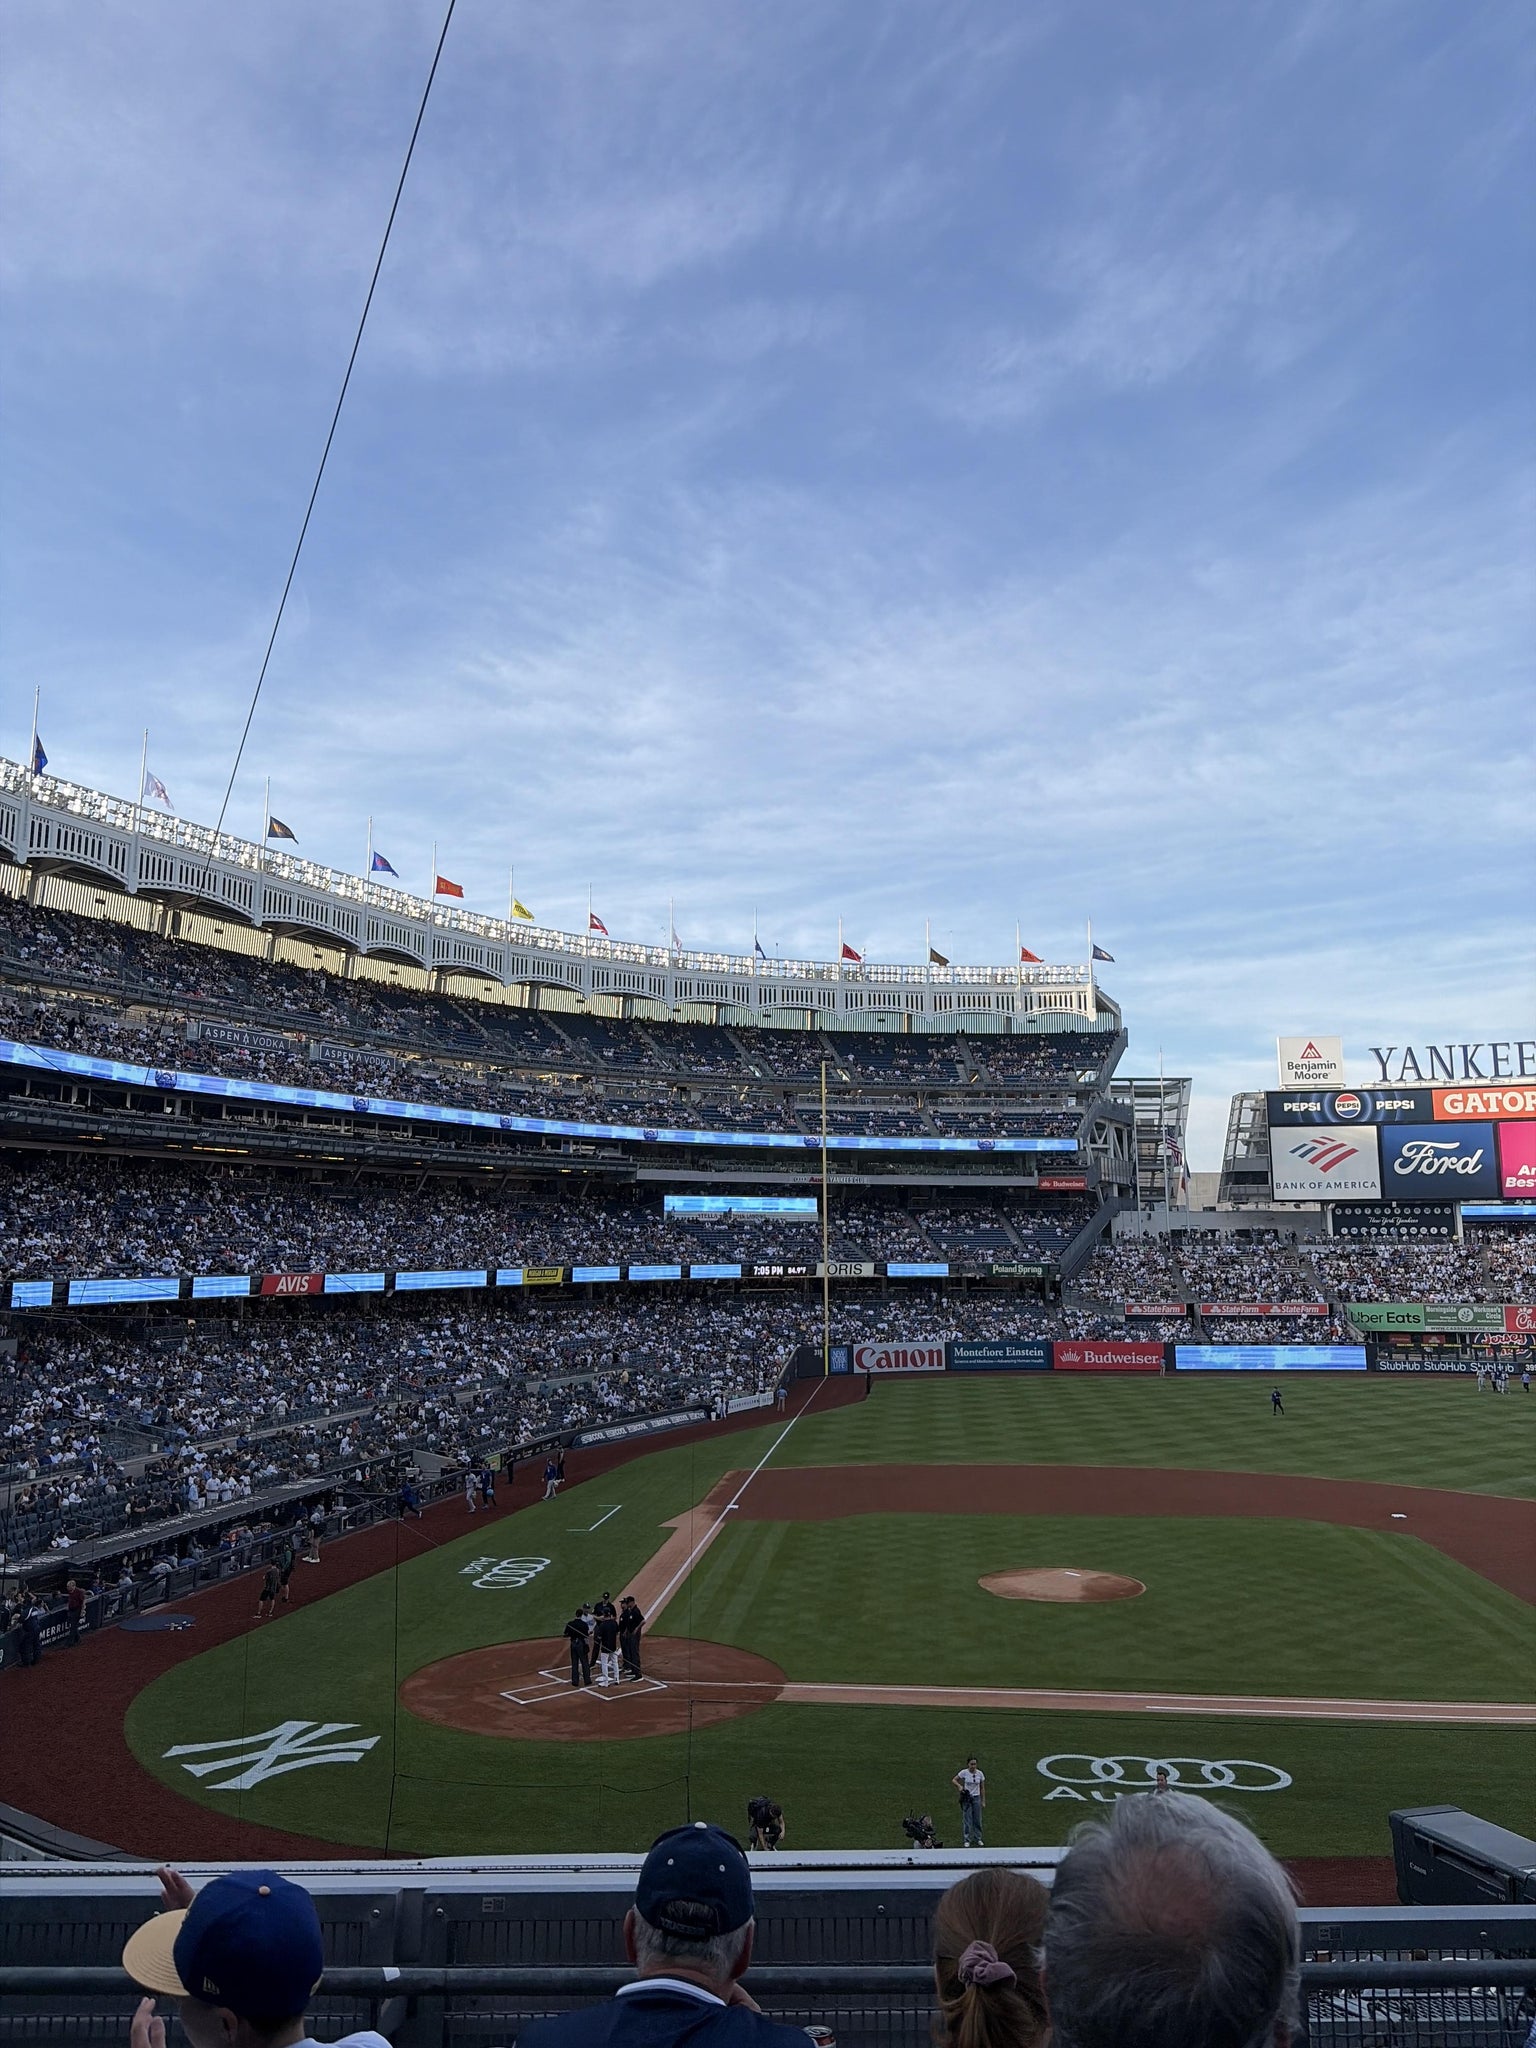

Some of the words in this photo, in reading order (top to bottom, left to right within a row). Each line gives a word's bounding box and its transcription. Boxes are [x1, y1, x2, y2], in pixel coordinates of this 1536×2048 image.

[205, 1027, 240, 1041] ASPEN
[252, 1035, 285, 1049] VODKA
[324, 1048, 354, 1062] ASPEN
[364, 1056, 391, 1068] VODKA
[1287, 1060, 1337, 1072] Benjamin
[1294, 1071, 1329, 1080] Moore
[1283, 1102, 1321, 1112] PEPSI
[1375, 1099, 1415, 1110] PEPSI
[1394, 1141, 1484, 1175] Ford
[1275, 1182, 1306, 1190] BANK
[1308, 1182, 1323, 1190] OF
[1326, 1180, 1377, 1190] AMERICA
[753, 1266, 770, 1276] 7:05
[771, 1265, 784, 1275] PM
[827, 1263, 863, 1275] ORIS
[992, 1264, 1018, 1274] Poland
[1017, 1264, 1043, 1275] Spring
[275, 1275, 310, 1293] AVIS
[1350, 1311, 1384, 1324] Uber
[1386, 1311, 1421, 1324] Eats
[1481, 1332, 1528, 1346] Jersey
[954, 1346, 1001, 1357] Montefiore
[1005, 1346, 1044, 1357] Einstein
[855, 1347, 943, 1370] Canon
[1380, 1361, 1421, 1371] StubHub
[1424, 1361, 1467, 1372] StubHub
[1409, 1861, 1427, 1876] Canon
